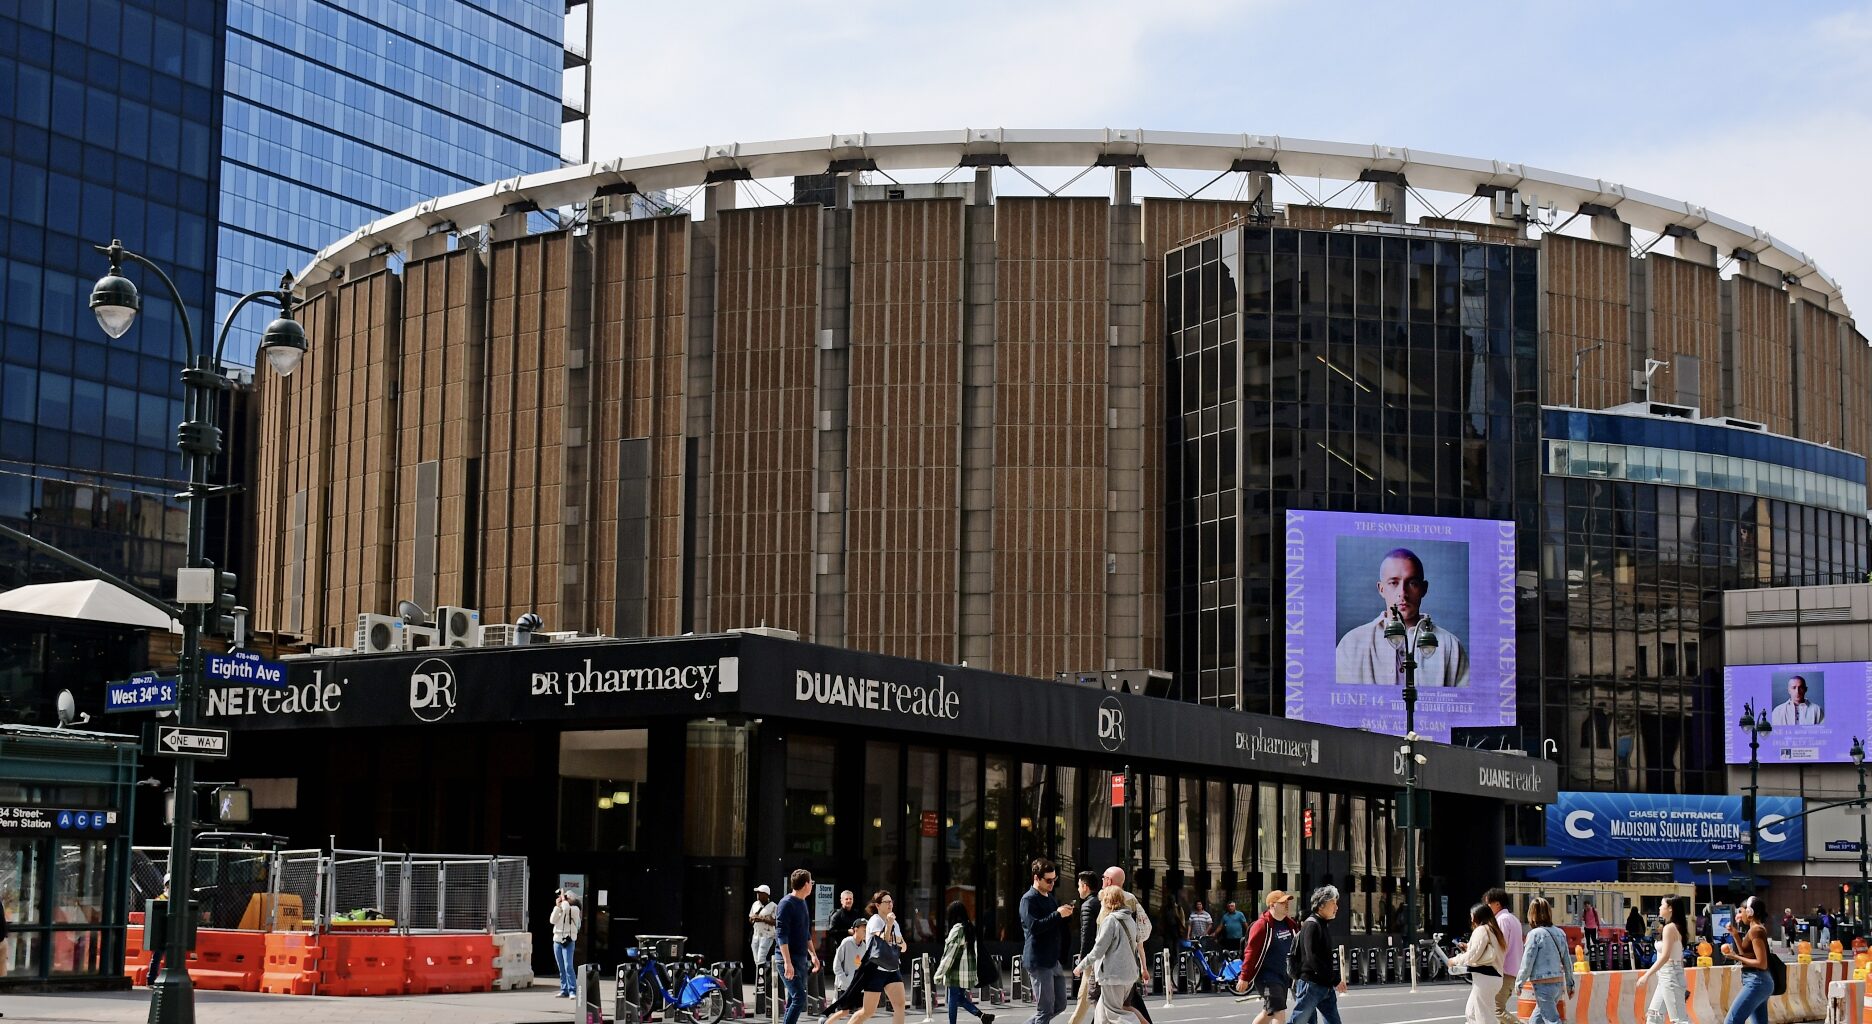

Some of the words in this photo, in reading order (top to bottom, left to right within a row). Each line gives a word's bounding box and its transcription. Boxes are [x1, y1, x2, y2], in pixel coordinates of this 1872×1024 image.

[1354, 521, 1376, 531] THE
[1378, 522, 1421, 533] SONDER
[1422, 524, 1453, 535] TOUR
[1286, 509, 1304, 636] KENNEDY
[1498, 521, 1516, 631] DERMOT
[211, 658, 252, 679] Eighth
[256, 664, 280, 681] Ave
[410, 672, 456, 708] DR
[531, 671, 562, 695] DR
[564, 659, 717, 706] pharmacy
[112, 689, 138, 705] West
[139, 685, 159, 702] 34th
[161, 685, 172, 701] St
[1330, 692, 1368, 706] JUNE
[1372, 696, 1384, 706] 14
[1098, 707, 1123, 742] DR
[1361, 718, 1387, 731] SASHA
[1419, 720, 1446, 732] SLOAN
[170, 735, 189, 745] ONE
[197, 737, 218, 747] WAY
[1250, 727, 1310, 766] pharmacy
[0, 808, 9, 817] 34
[61, 814, 69, 825] A
[78, 815, 86, 826] C
[94, 815, 102, 826] E
[1629, 810, 1659, 818] CHASE
[1670, 811, 1724, 820] ENTRANCE
[21, 818, 51, 829] Station
[1610, 819, 1657, 836] MADISON
[1660, 820, 1698, 838] SQUARE
[1701, 821, 1740, 839] GARDEN
[1647, 861, 1670, 870] STATION
